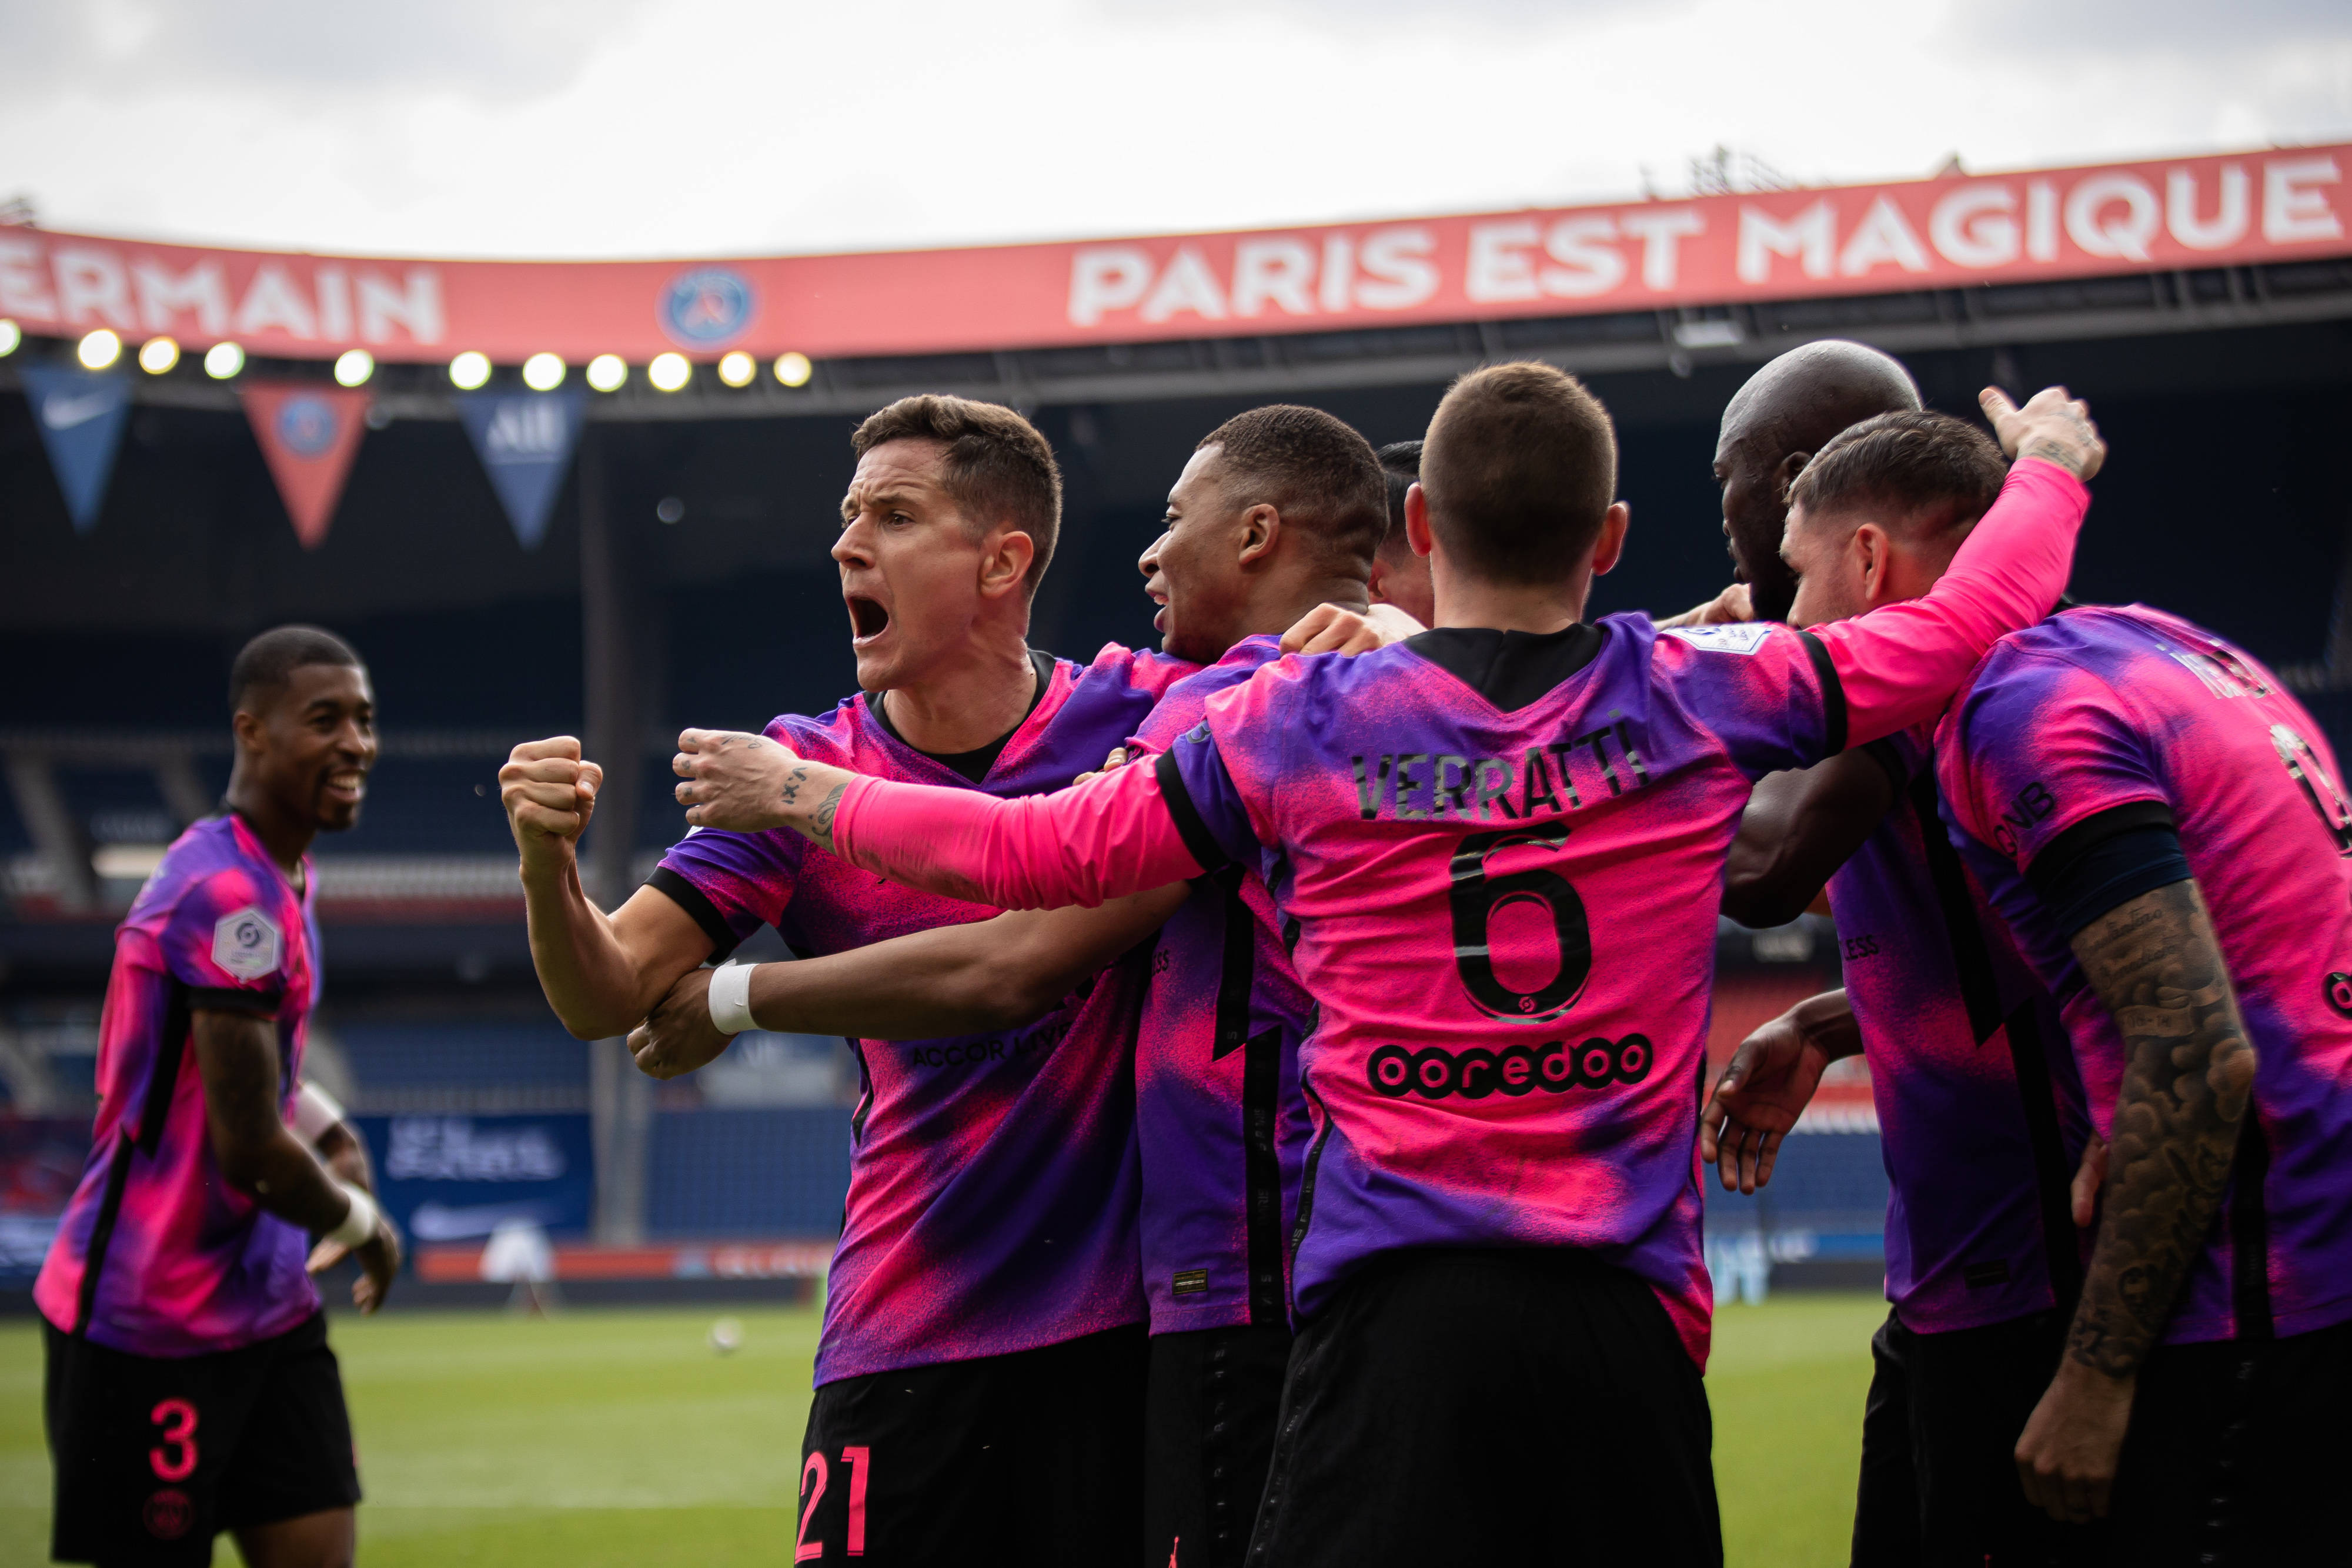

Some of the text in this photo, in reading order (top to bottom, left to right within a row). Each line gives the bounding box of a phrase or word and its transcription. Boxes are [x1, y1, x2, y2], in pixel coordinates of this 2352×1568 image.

[1067, 155, 2343, 327] PARIS EST MAGIQUE
[1352, 708, 1649, 821] VERRATTI
[1449, 823, 1592, 1025] 6
[913, 1039, 1008, 1067] ACCOR
[1375, 1040, 1646, 1091] ooredoo
[148, 1396, 199, 1483] 3
[793, 1446, 870, 1564] 21
